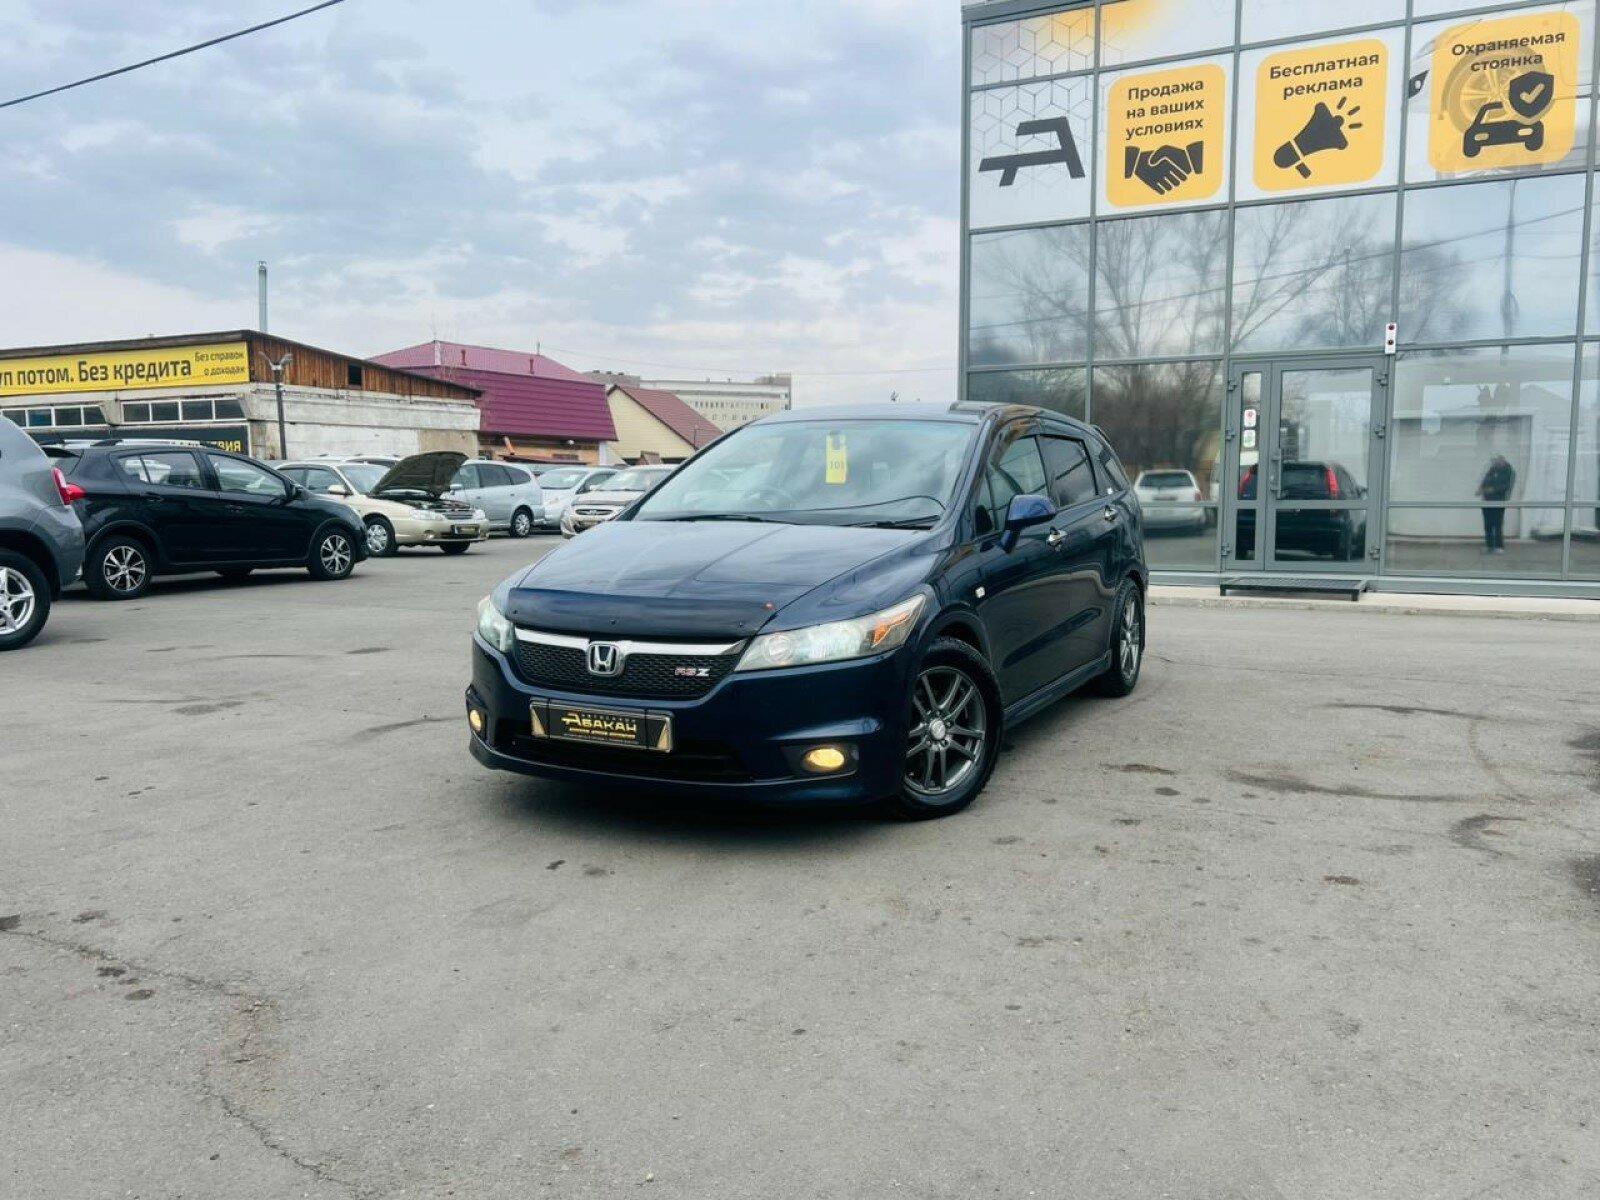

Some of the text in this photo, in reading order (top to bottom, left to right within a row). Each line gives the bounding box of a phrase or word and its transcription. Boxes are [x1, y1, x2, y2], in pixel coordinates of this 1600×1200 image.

[1451, 32, 1566, 57] Охраняемая
[1269, 54, 1380, 80] Бесплатная
[1470, 53, 1543, 72] стоянка
[1128, 79, 1204, 101] Продажа
[1282, 76, 1364, 101] реклама
[1126, 99, 1205, 120] на ваших
[1125, 118, 1204, 140] условиях
[194, 351, 209, 361] Без
[17, 368, 74, 386] потом.
[78, 361, 109, 382] Без
[113, 359, 192, 384] кредита
